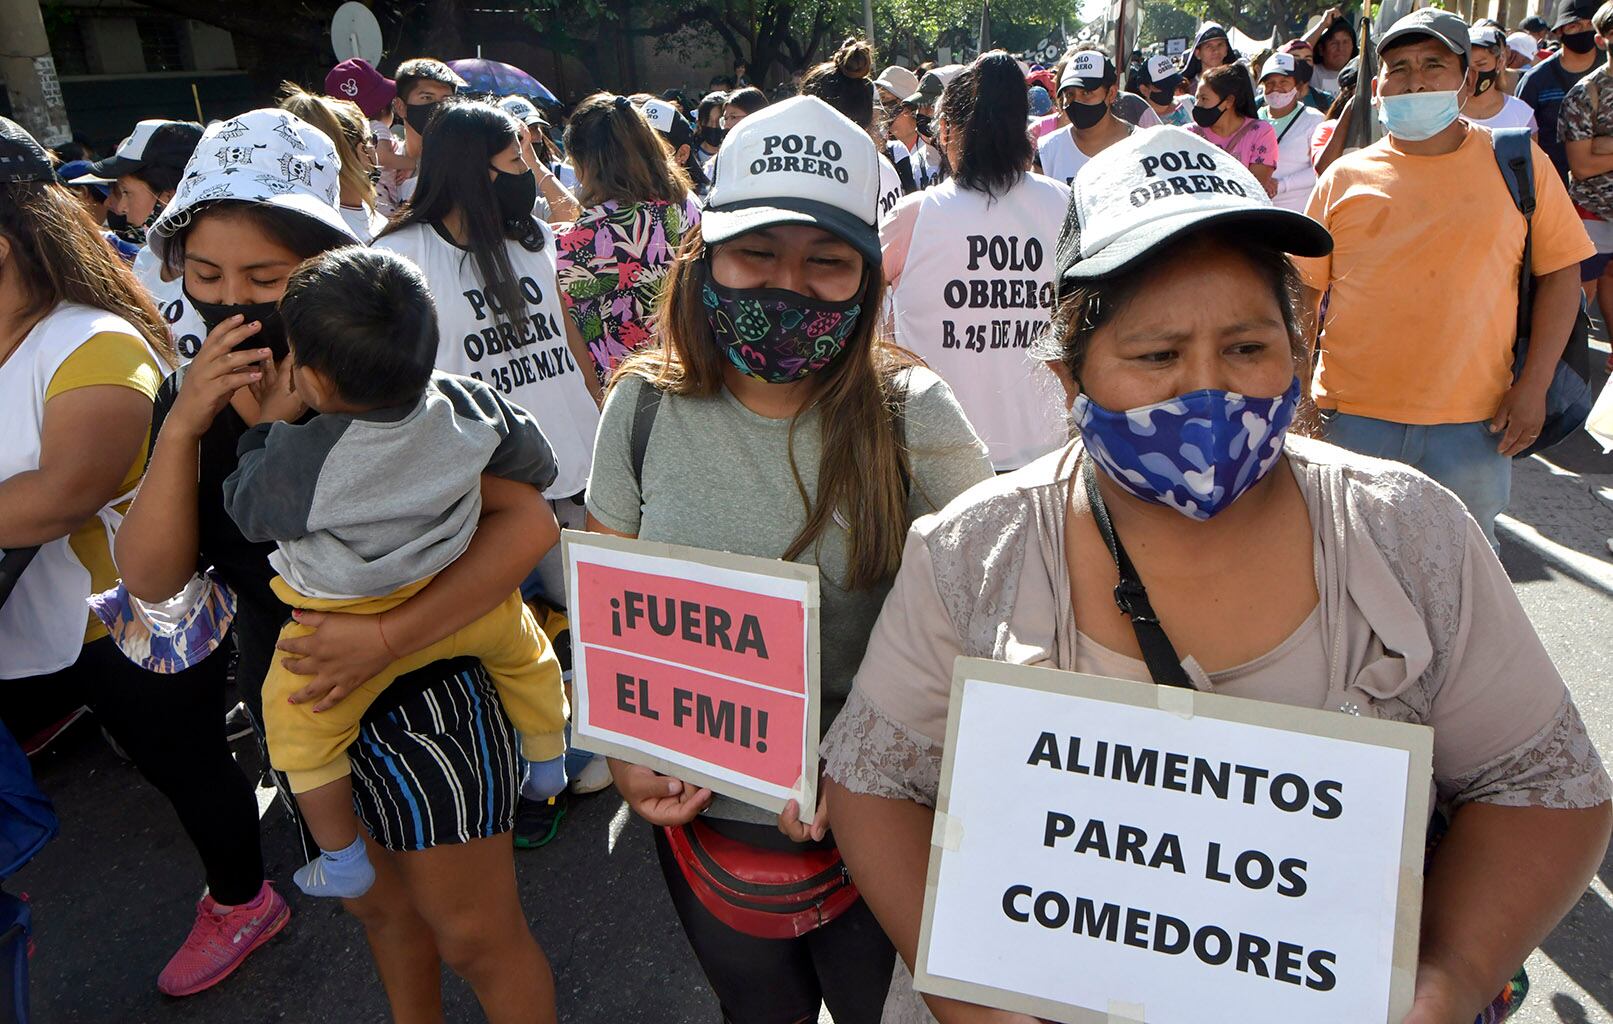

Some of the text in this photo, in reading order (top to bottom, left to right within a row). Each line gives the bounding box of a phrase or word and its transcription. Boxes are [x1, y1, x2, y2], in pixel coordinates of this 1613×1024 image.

[763, 134, 842, 161] POLO
[1139, 150, 1217, 177] POLO
[750, 156, 849, 184] OBRERO
[1130, 175, 1247, 207] OBRERO
[966, 235, 1043, 272] POLO
[463, 276, 543, 320] POO
[944, 279, 1055, 309] OBRERO
[942, 320, 960, 349] B.
[965, 325, 986, 353] 25
[990, 320, 1012, 348] DE
[491, 366, 512, 394] 25
[508, 356, 536, 387] DE
[610, 590, 769, 660] ¡FUERA
[616, 673, 769, 753] EL FMI!
[1027, 731, 1343, 820] ALIMENTOS
[1043, 811, 1308, 898] PARA LOS
[1002, 885, 1337, 992] COMEDORES
